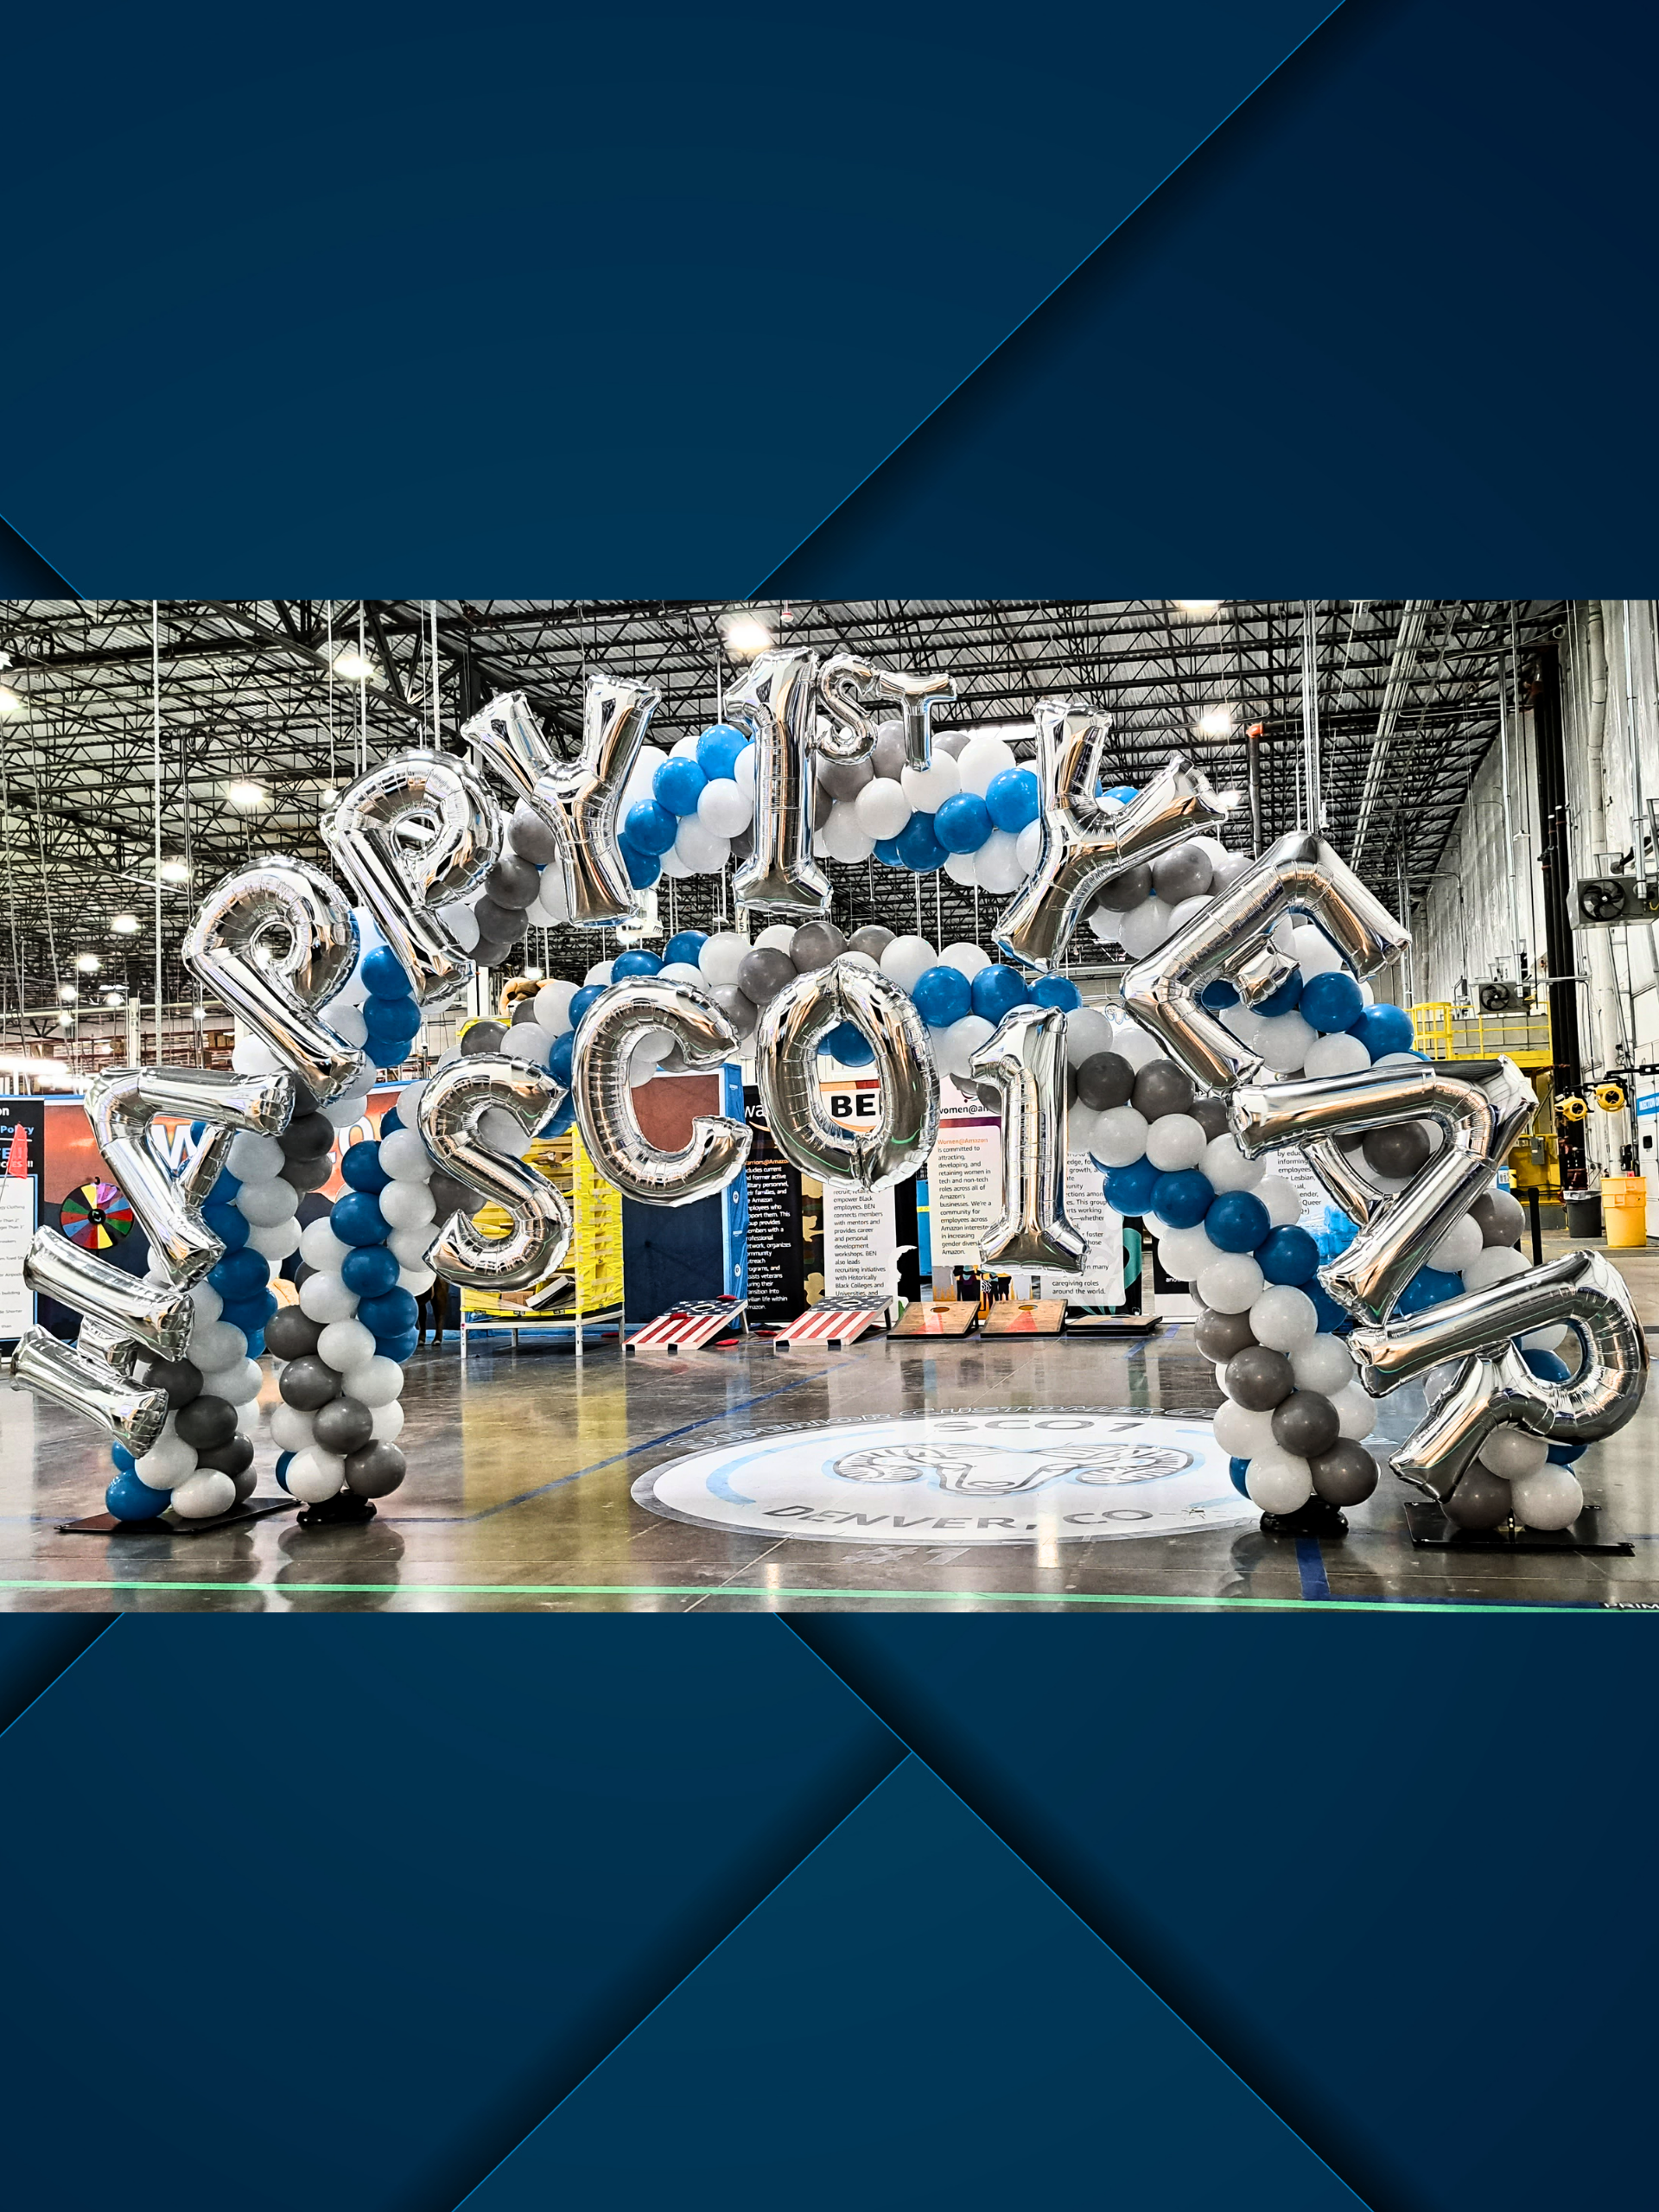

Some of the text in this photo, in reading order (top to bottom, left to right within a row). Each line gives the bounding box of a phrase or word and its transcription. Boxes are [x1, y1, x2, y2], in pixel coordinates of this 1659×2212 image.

[831, 1093, 881, 1118] BE
[994, 698, 1649, 1504] YEAR
[759, 1218, 781, 1227] provides
